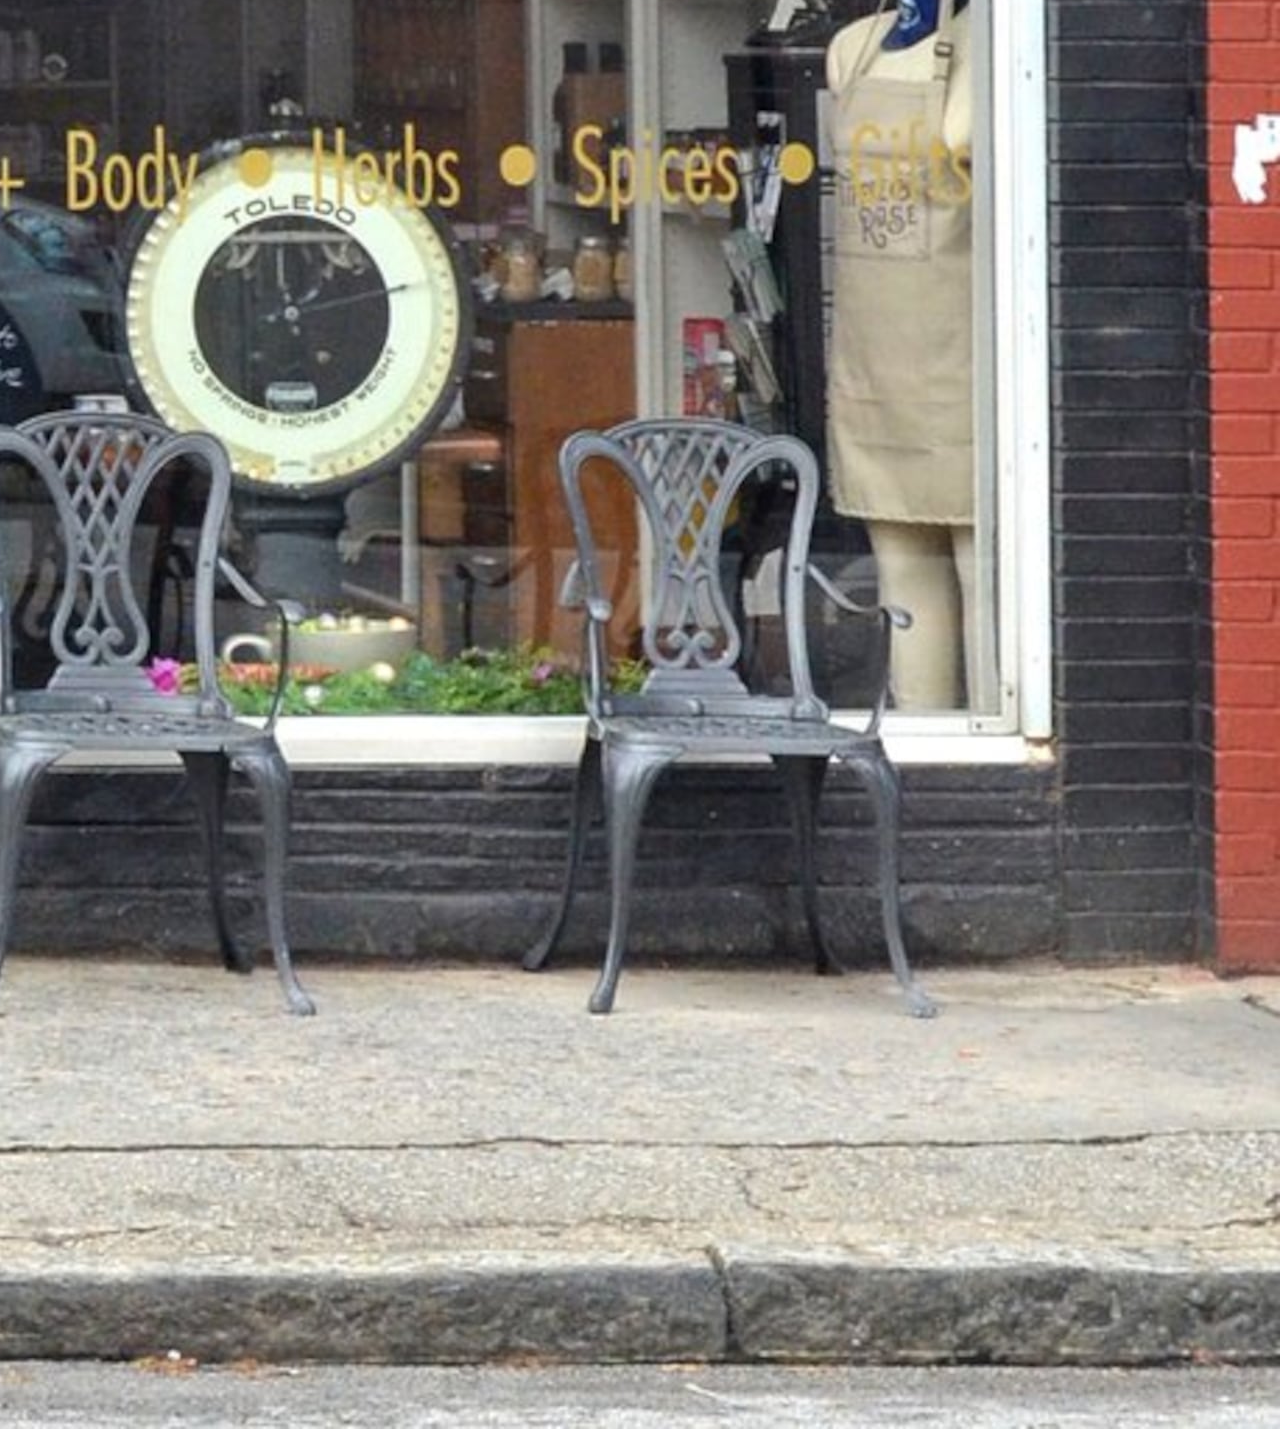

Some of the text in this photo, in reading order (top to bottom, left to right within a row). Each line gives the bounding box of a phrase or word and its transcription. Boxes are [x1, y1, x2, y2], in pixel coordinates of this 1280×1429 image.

[65, 124, 198, 226] Body
[313, 122, 461, 208] Herbs
[572, 123, 737, 224] Spices
[224, 194, 357, 226] TOLEDO
[203, 377, 267, 424] SPRINGS
[280, 403, 349, 427] HONEST
